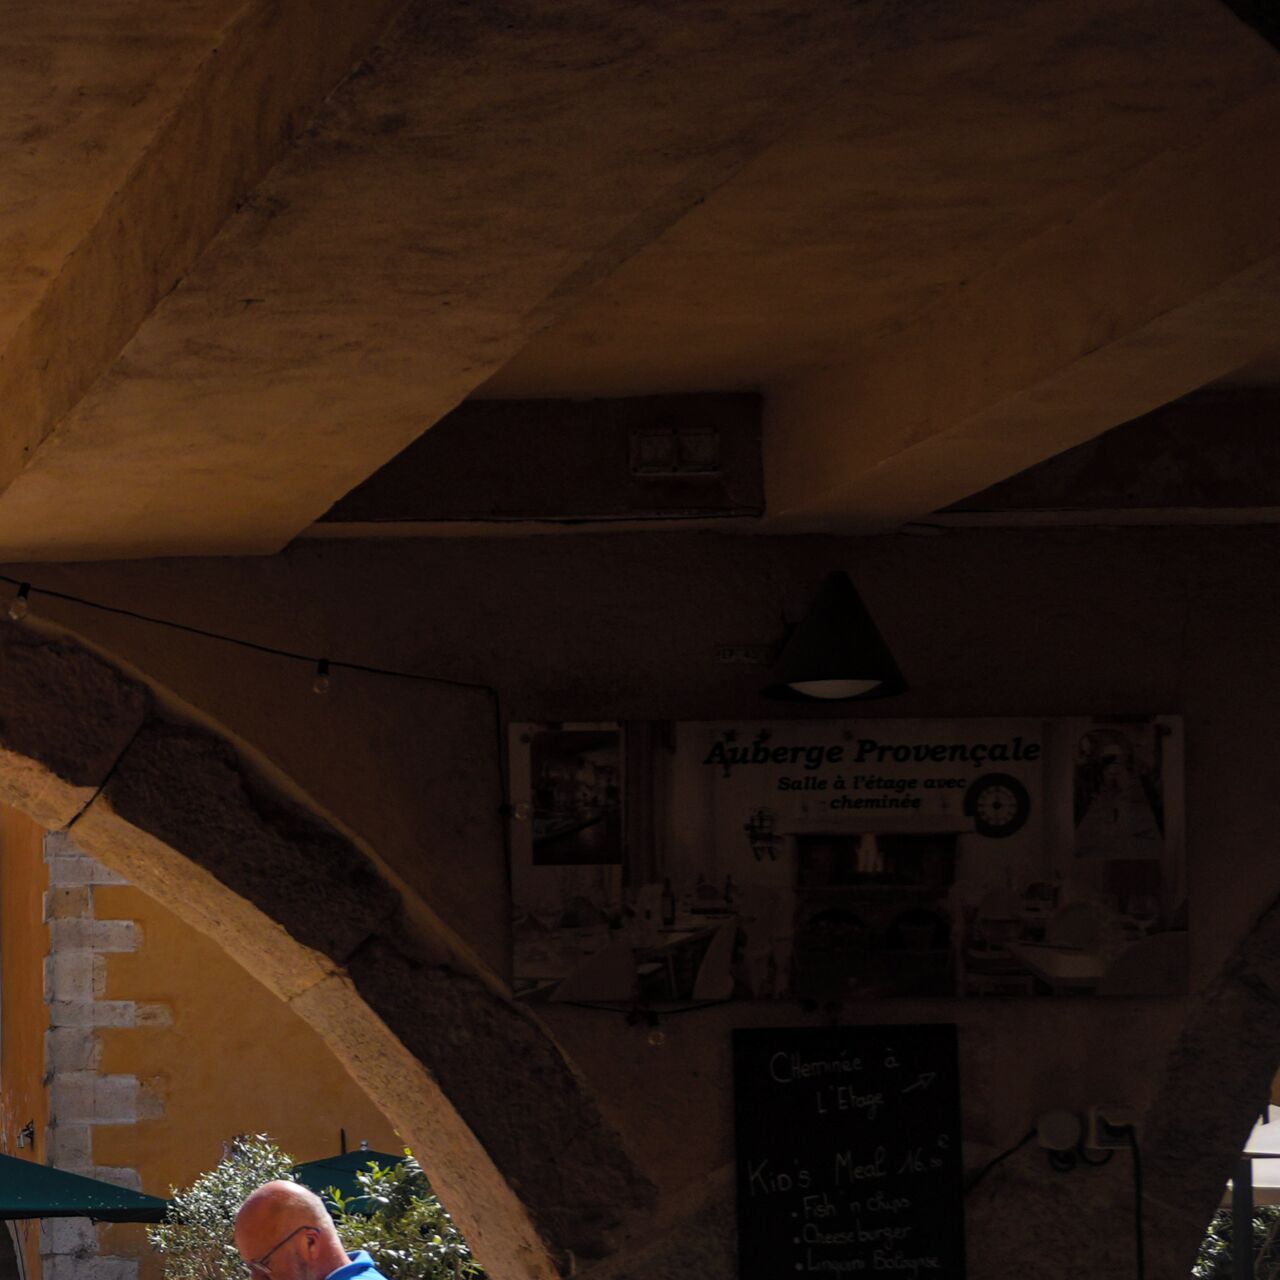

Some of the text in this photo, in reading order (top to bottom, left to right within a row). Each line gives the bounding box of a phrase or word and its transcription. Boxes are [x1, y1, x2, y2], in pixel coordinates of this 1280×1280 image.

[703, 737, 1041, 771] Auberge Provençale
[777, 774, 966, 795] Salle à l'étage avec
[830, 796, 921, 810] cheminée
[834, 1145, 888, 1185] Meal
